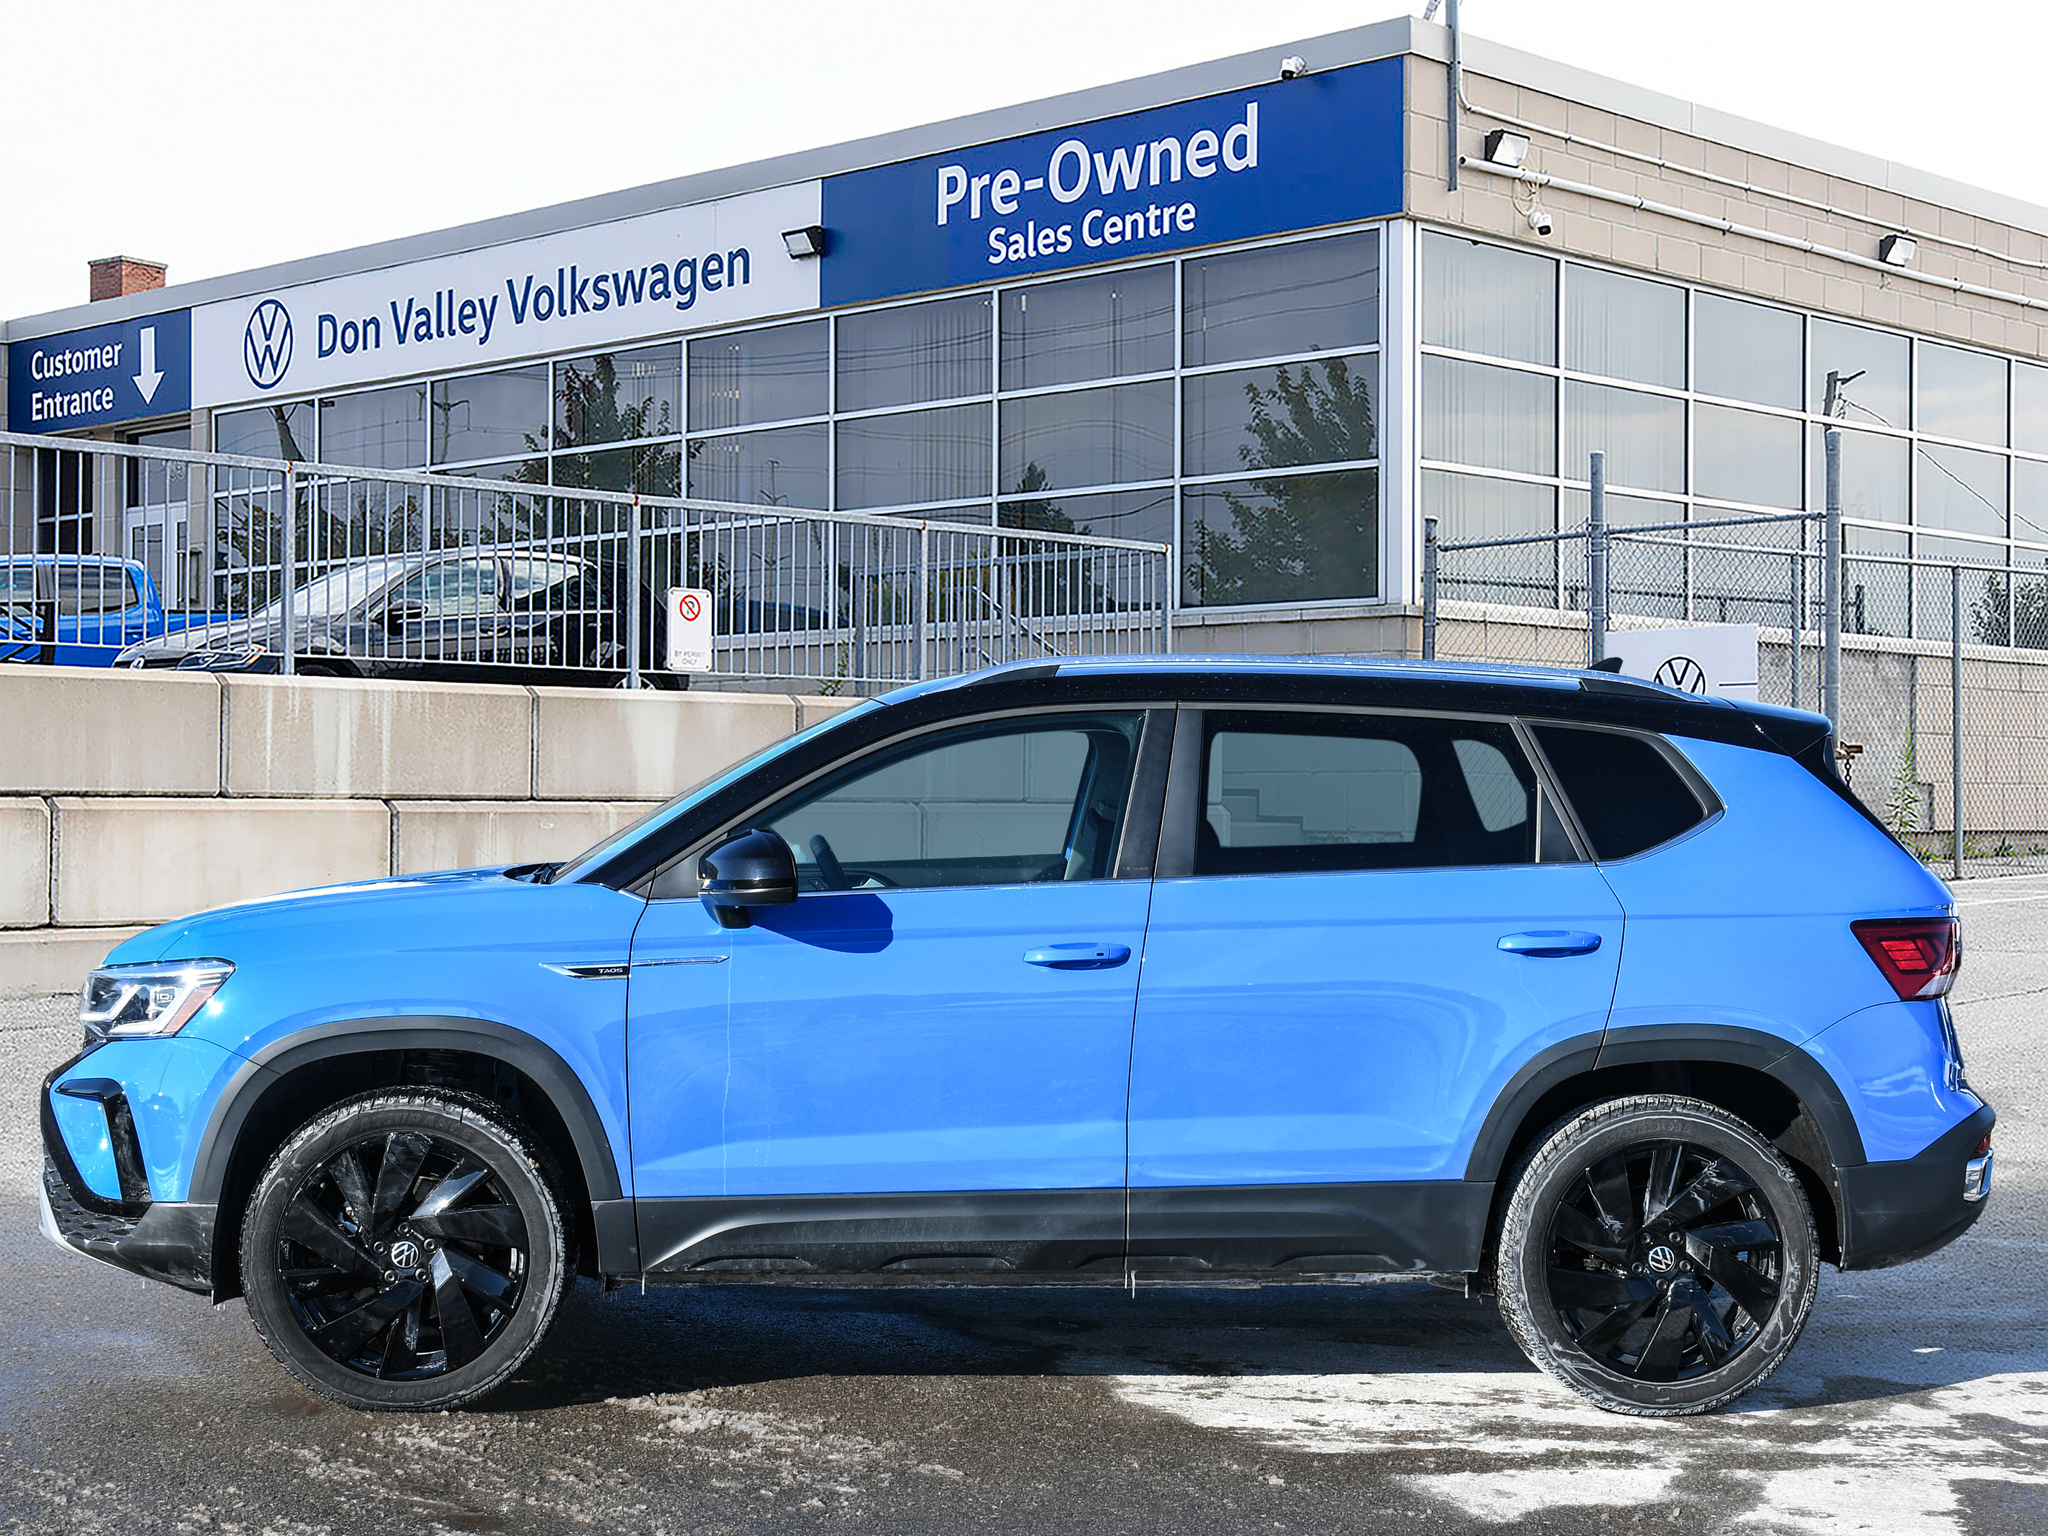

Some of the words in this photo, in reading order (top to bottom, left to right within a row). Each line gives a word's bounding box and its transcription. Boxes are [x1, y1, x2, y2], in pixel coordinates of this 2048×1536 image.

[937, 102, 1259, 226] Pre-Owned
[988, 221, 1073, 264] Sales
[1082, 202, 1196, 248] Centre
[318, 313, 380, 359] Don
[390, 289, 499, 345] Valley
[506, 246, 750, 324] Volkswagen
[32, 343, 123, 380] Customer
[32, 387, 114, 421] Entrance
